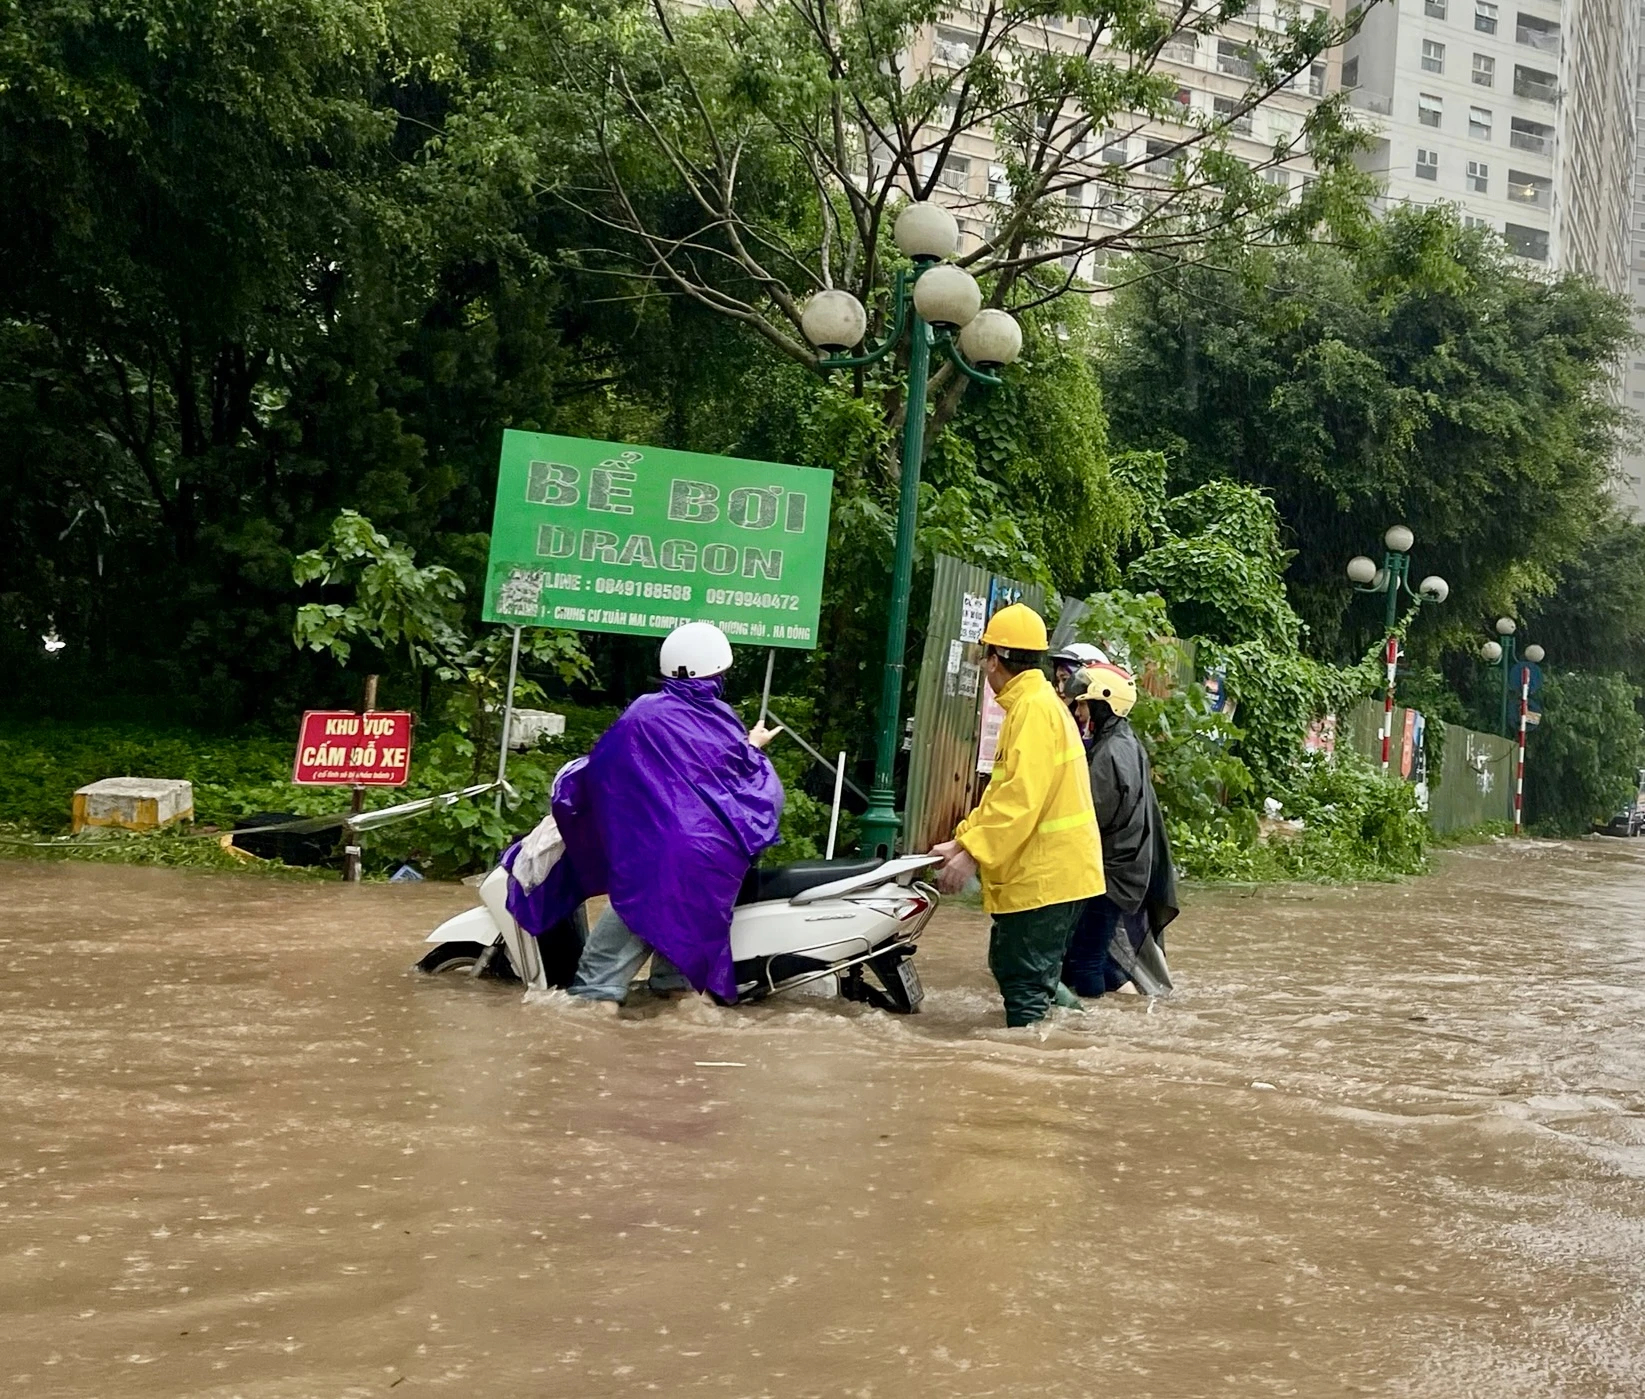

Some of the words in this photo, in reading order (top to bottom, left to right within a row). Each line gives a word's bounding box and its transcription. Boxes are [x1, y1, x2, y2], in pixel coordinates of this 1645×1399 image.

[525, 451, 644, 515] BỂ
[667, 478, 808, 534] BƠI
[536, 524, 784, 581] DRAGON
[706, 588, 800, 611] 0979940472
[554, 606, 586, 622] CHUNG
[587, 608, 602, 623] CƯ
[602, 609, 627, 625] XUÂN
[628, 612, 646, 627] MAI
[325, 719, 359, 736] KHU
[363, 718, 395, 739] VỰC
[302, 740, 346, 767] CẤM
[350, 741, 377, 767] ĐỖ
[380, 748, 406, 767] XE
